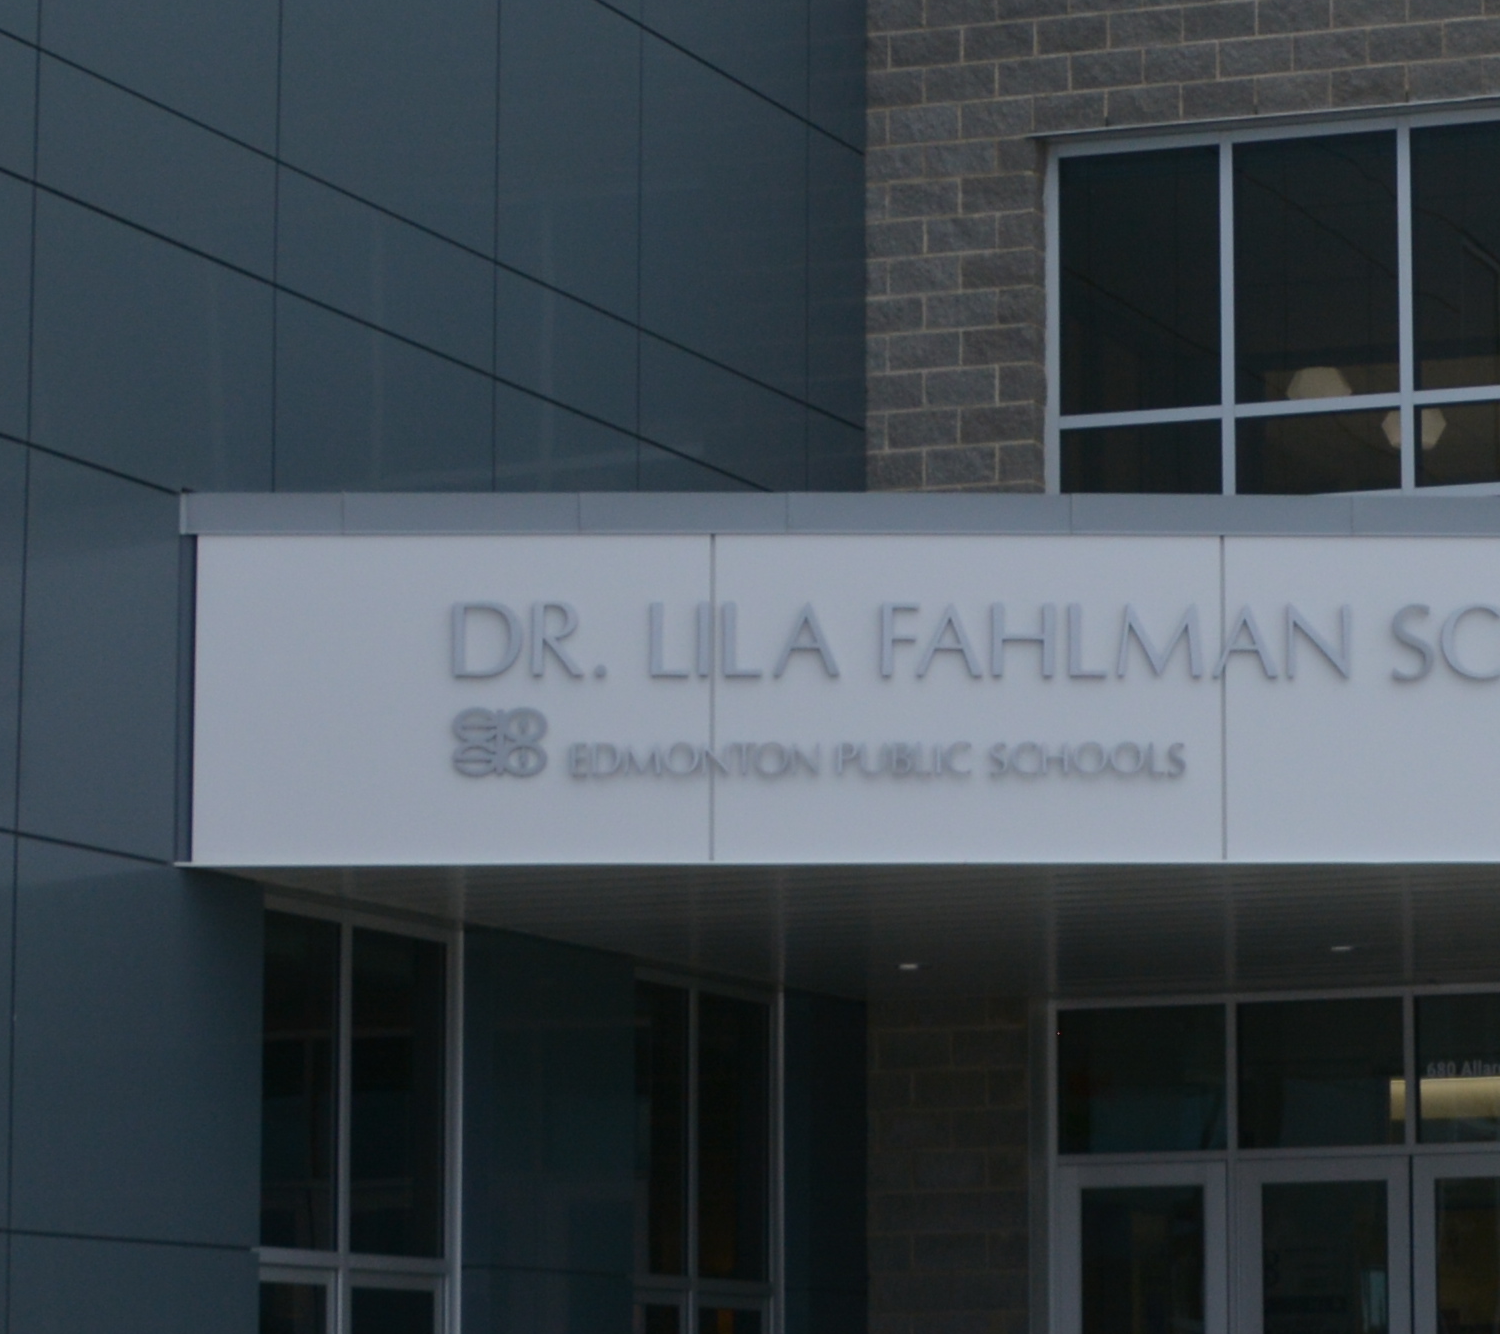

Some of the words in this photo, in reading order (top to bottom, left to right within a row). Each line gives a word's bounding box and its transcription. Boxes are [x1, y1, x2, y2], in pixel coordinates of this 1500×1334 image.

[450, 600, 608, 683] DR.
[647, 600, 842, 681] LILA
[879, 601, 1352, 683] FAHLMAN
[568, 741, 821, 780] EDMONTON
[834, 741, 975, 780] PUBLIC
[987, 740, 1189, 781] SCHOOLS
[1427, 1063, 1456, 1078] 680
